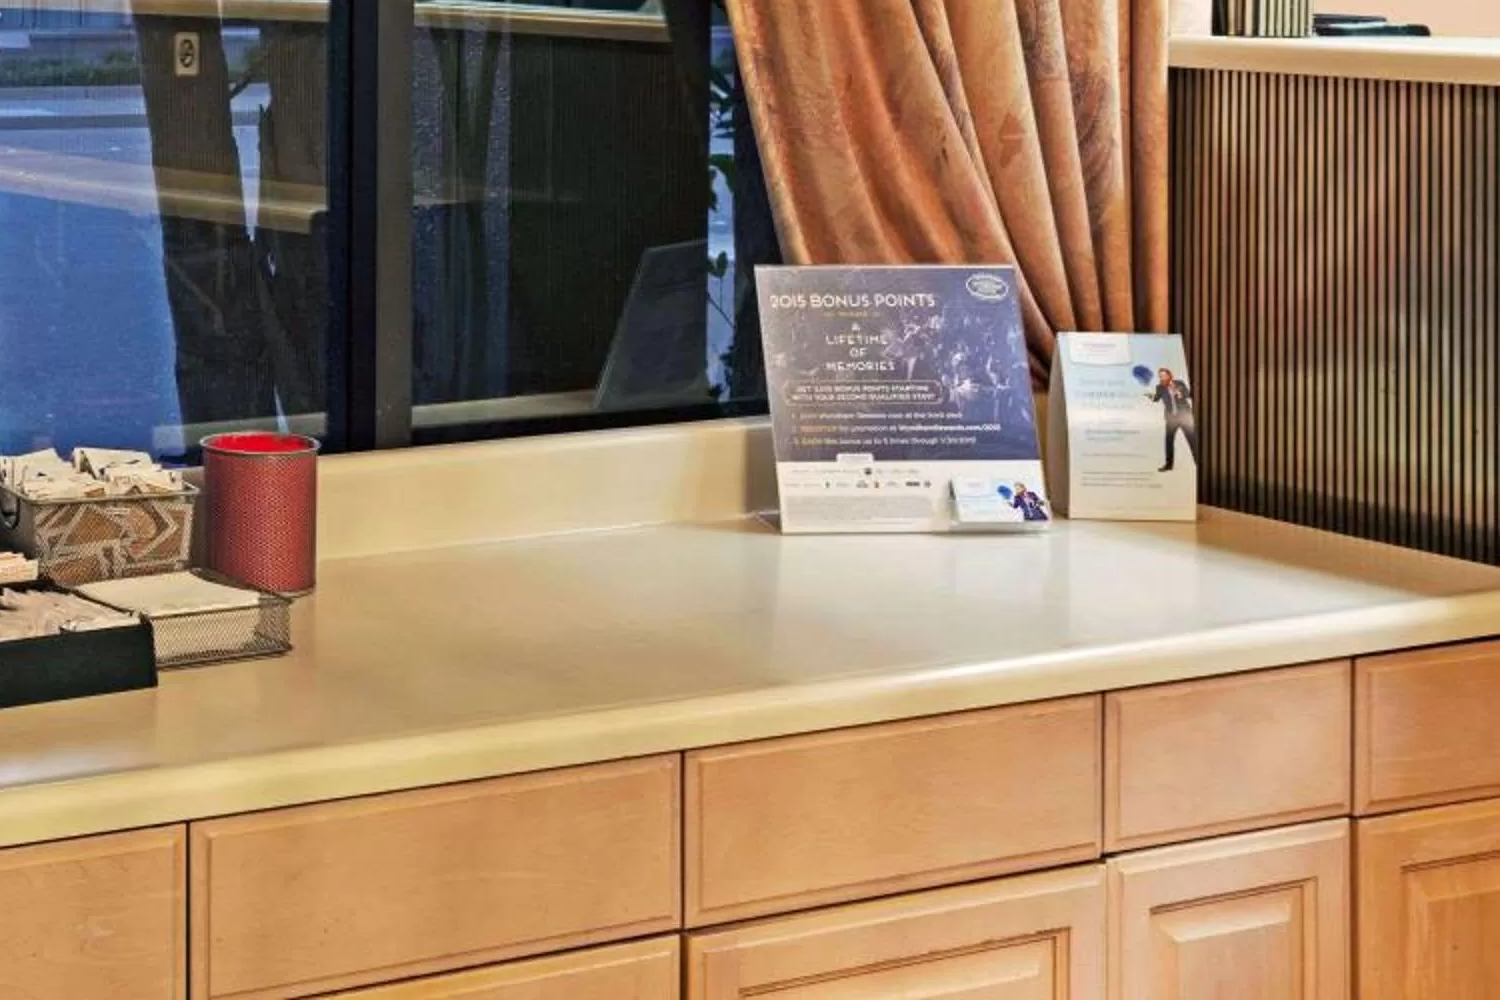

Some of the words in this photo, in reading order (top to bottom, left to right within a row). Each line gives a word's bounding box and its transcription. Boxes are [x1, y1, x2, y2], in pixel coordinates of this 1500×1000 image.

[769, 294, 807, 309] 2015
[810, 294, 870, 308] BONUS
[875, 292, 937, 307] POINTS
[825, 334, 888, 346] LIFETIME
[849, 348, 868, 358] OF
[825, 360, 896, 372] MEMORIES
